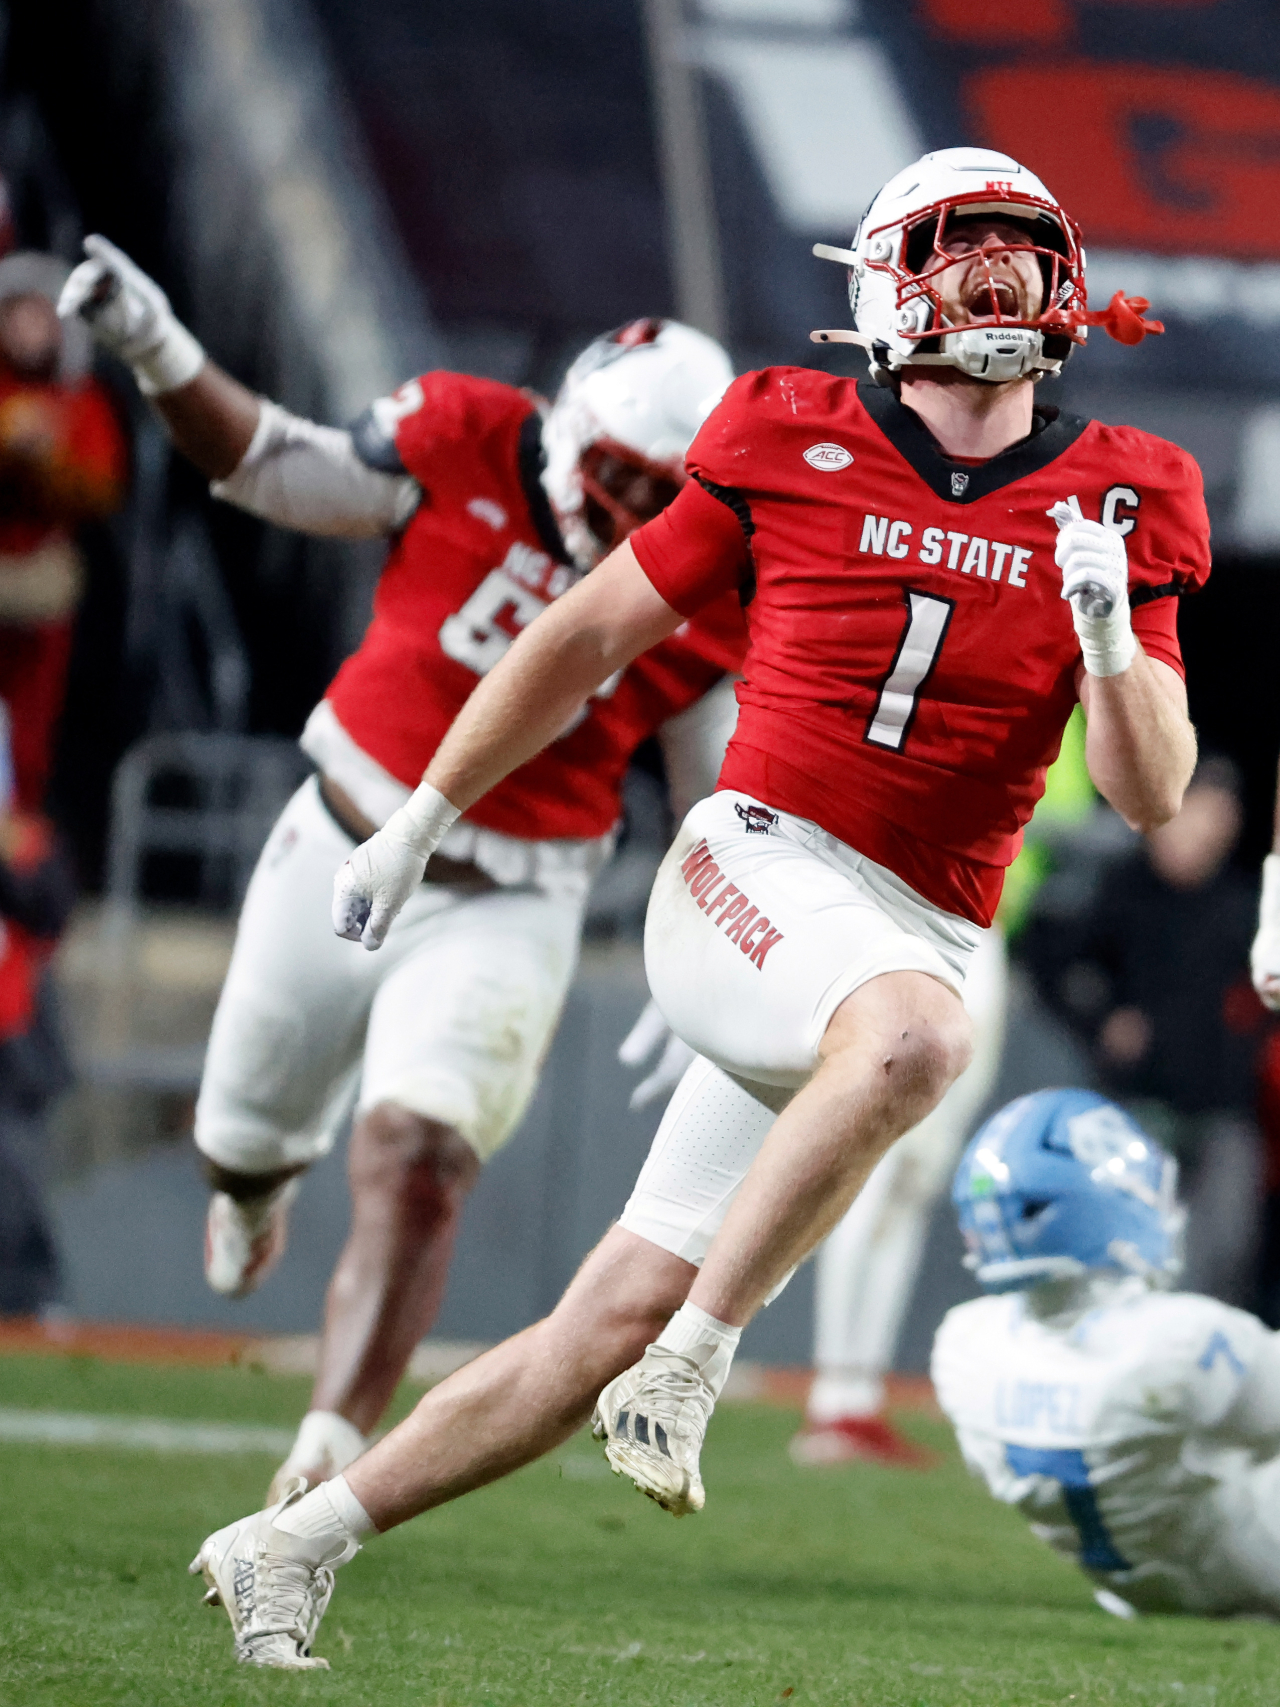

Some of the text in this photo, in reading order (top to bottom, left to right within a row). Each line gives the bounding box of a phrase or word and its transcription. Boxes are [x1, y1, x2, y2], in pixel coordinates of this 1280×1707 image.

[985, 332, 1024, 342] Riddell
[858, 513, 1034, 588] NC STATE
[1101, 485, 1141, 537] C
[863, 588, 954, 752] 1
[681, 837, 785, 972] WOLFPACK
[1003, 1442, 1132, 1571] 7
